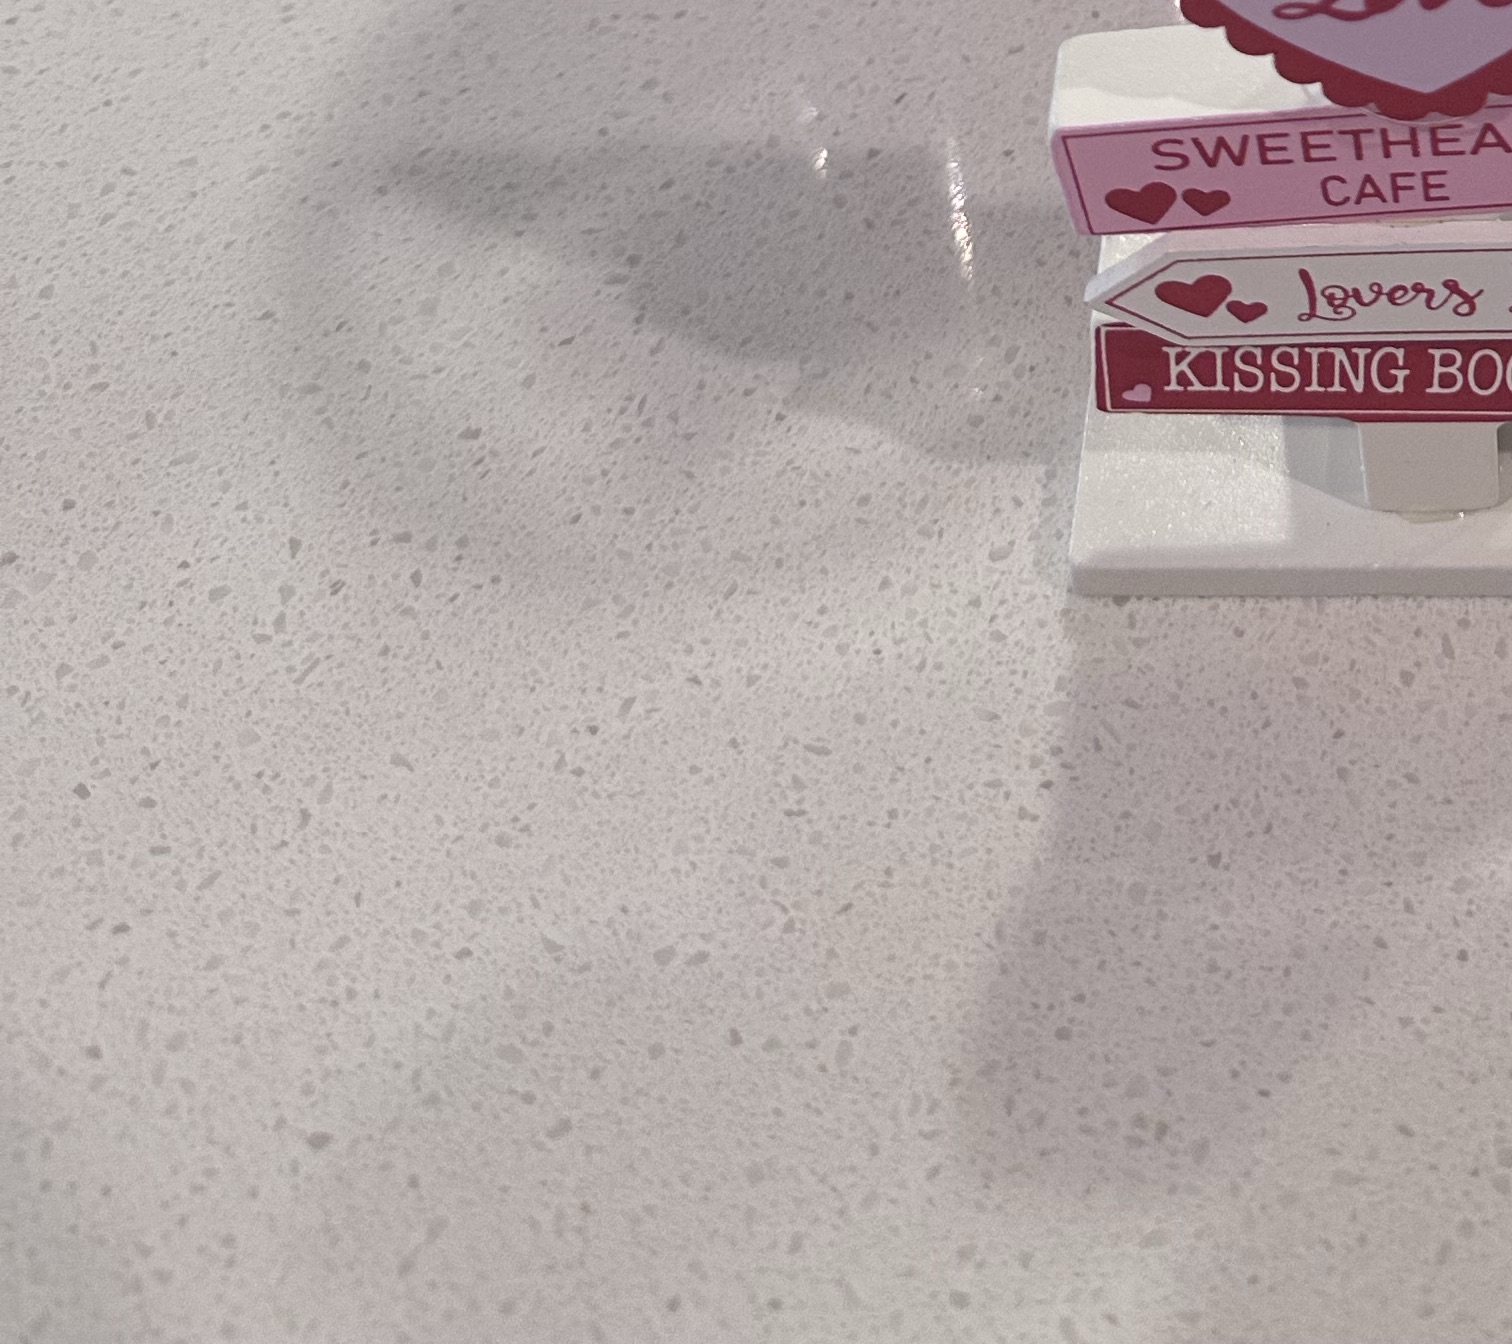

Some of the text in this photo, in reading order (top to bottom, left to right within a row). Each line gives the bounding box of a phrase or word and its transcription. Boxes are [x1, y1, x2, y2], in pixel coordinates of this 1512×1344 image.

[1320, 171, 1451, 207] CAFE
[1299, 269, 1484, 323] Lovers
[1163, 347, 1410, 393] KISSING
